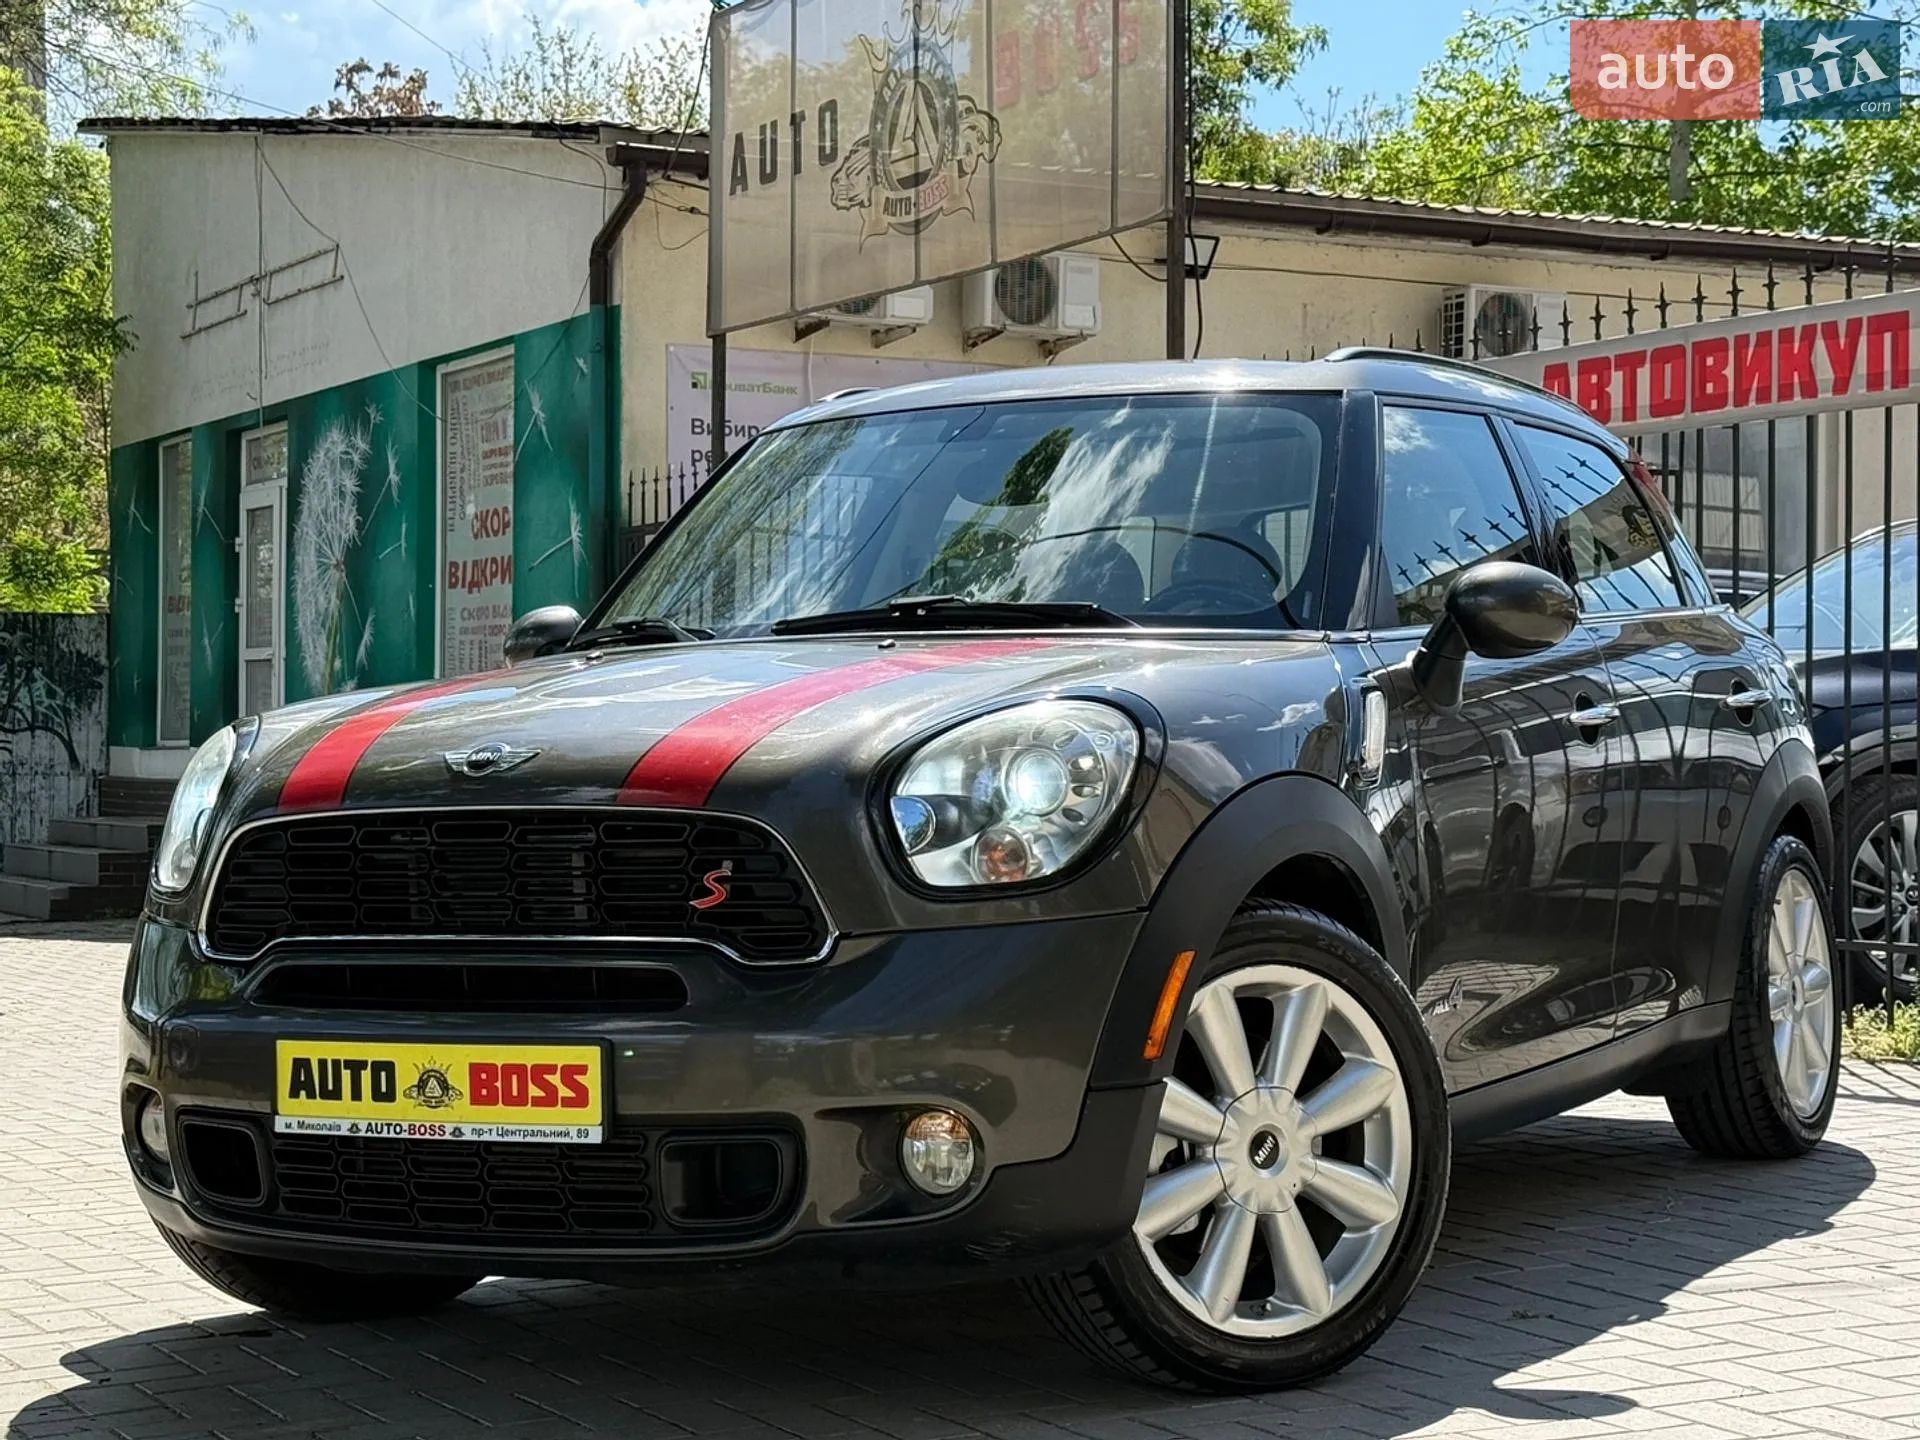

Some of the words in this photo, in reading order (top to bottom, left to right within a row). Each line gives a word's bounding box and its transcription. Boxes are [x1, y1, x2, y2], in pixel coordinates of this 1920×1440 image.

[729, 98, 839, 197] AUTO
[1543, 310, 1911, 425] АВТОВИКУП
[708, 379, 798, 396] иватБанк
[690, 417, 767, 440] Вбир
[471, 506, 511, 540] СКОР
[447, 555, 512, 594] ВІДКРИ
[689, 869, 732, 909] S
[288, 1056, 398, 1103] AUTO
[468, 1061, 590, 1109] BOSS
[365, 1122, 446, 1137] AUTO-BOSS
[471, 1127, 493, 1138] пр-т
[496, 1126, 573, 1140] Центральний,
[576, 1128, 589, 1138] 89
[1254, 1135, 1275, 1165] MINI
